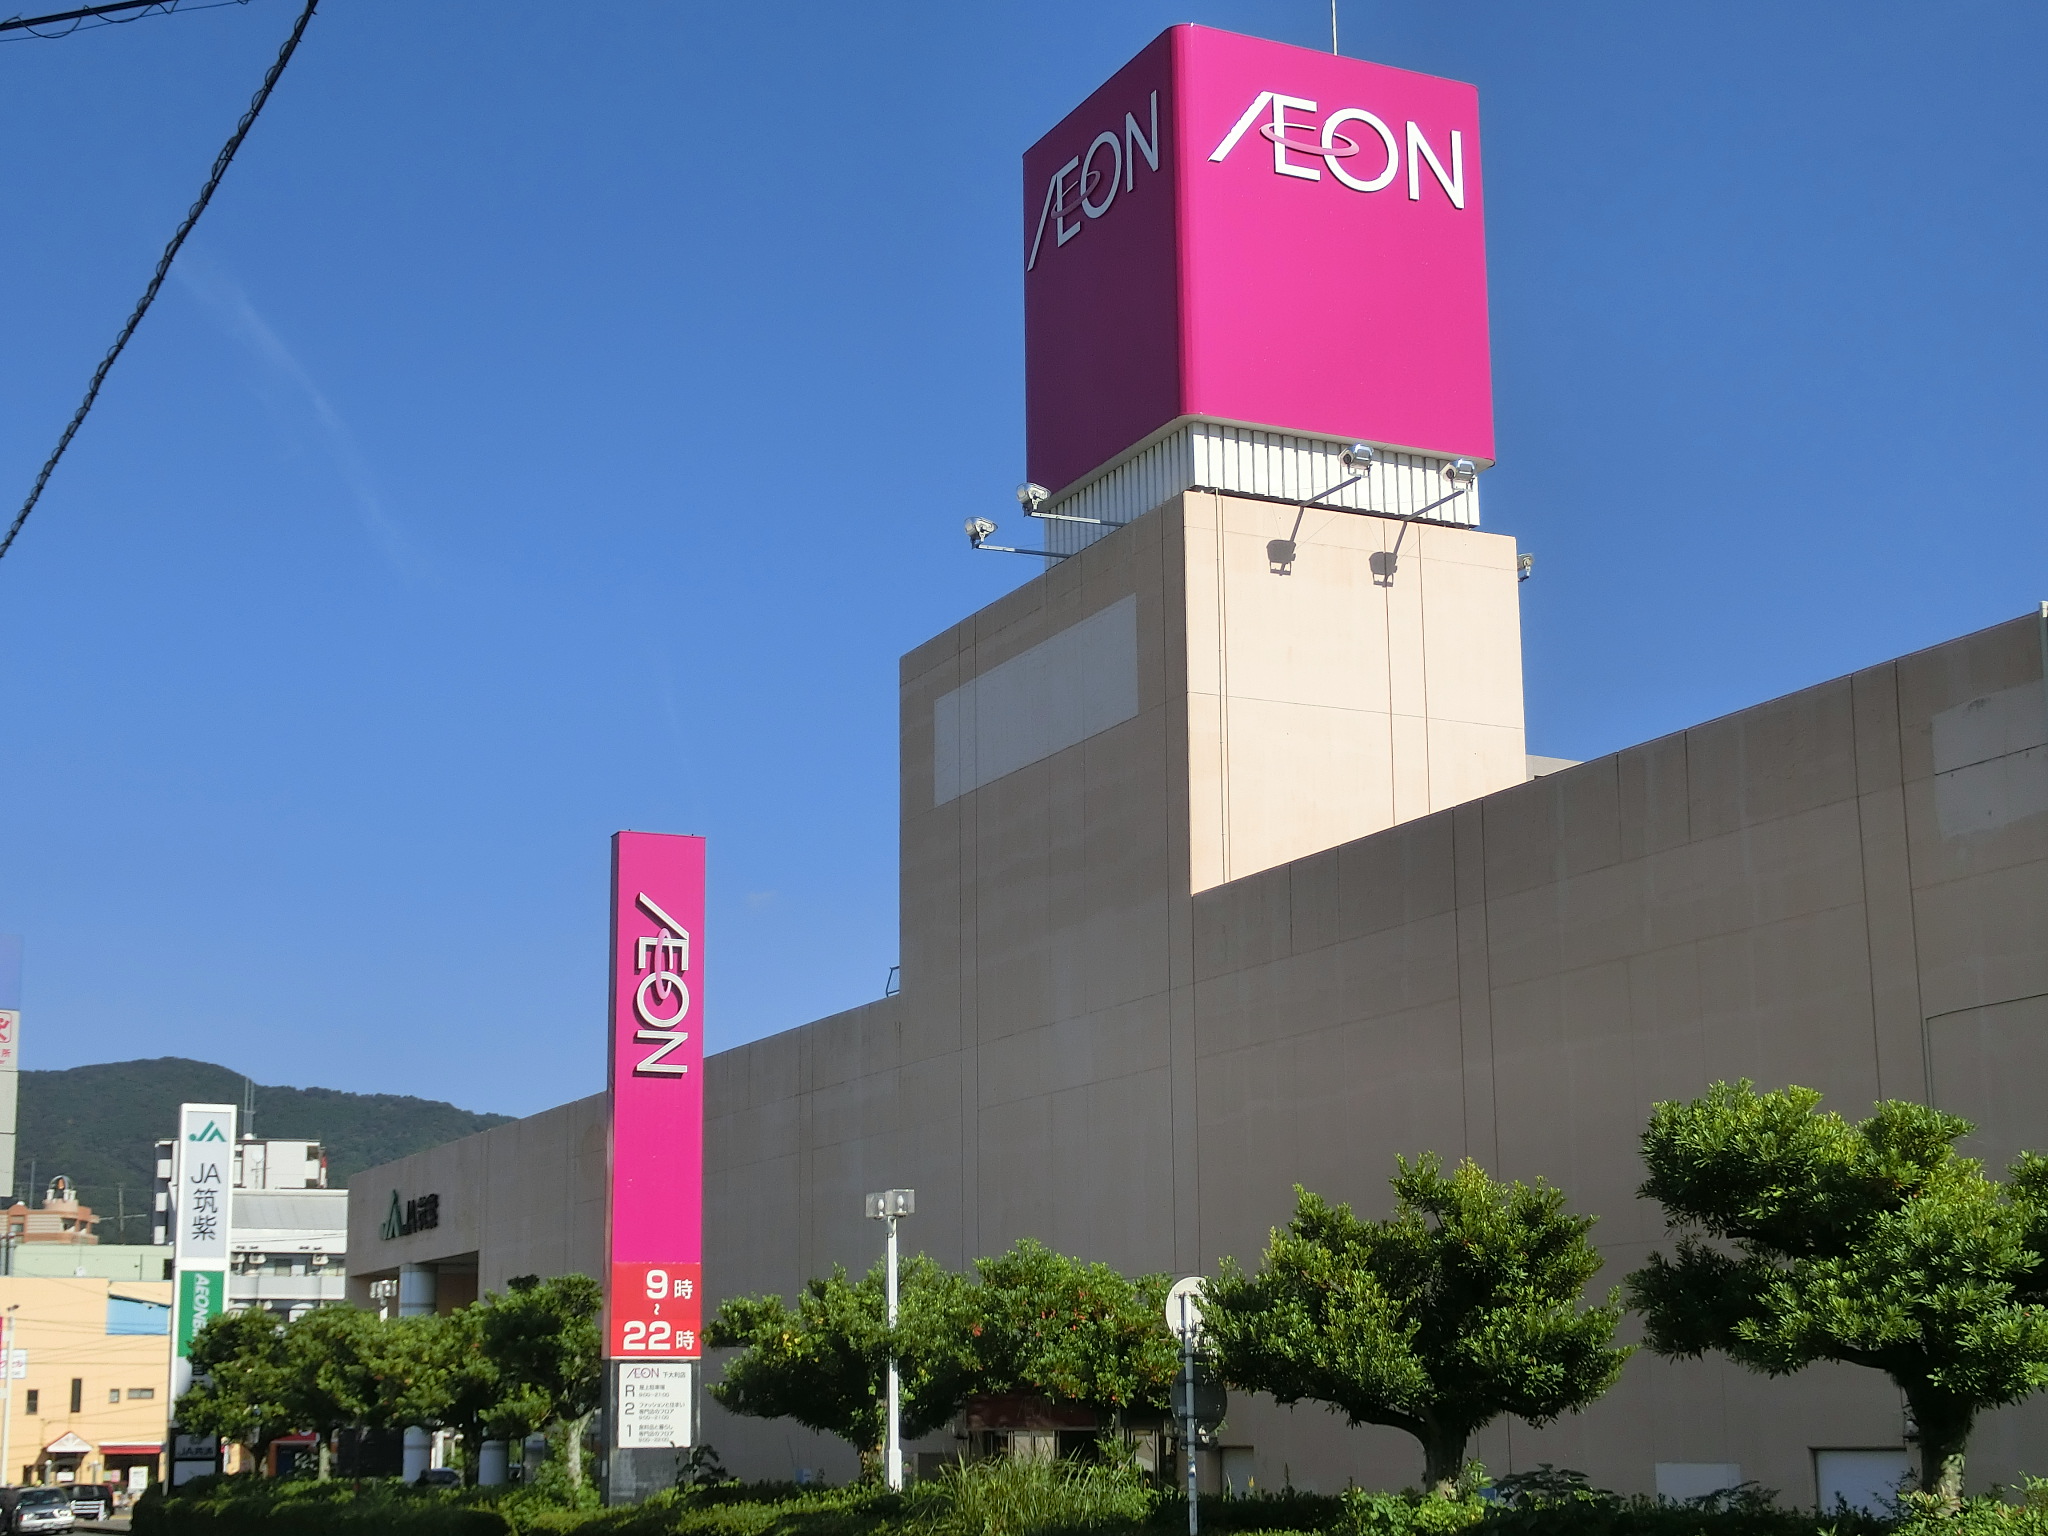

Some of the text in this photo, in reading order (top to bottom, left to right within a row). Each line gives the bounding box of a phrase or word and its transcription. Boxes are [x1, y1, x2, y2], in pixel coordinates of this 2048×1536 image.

[646, 1269, 693, 1300] 9時
[623, 1320, 695, 1350] 22時
[625, 1384, 635, 1397] R
[625, 1402, 635, 1415] 2
[626, 1424, 632, 1438] 1
